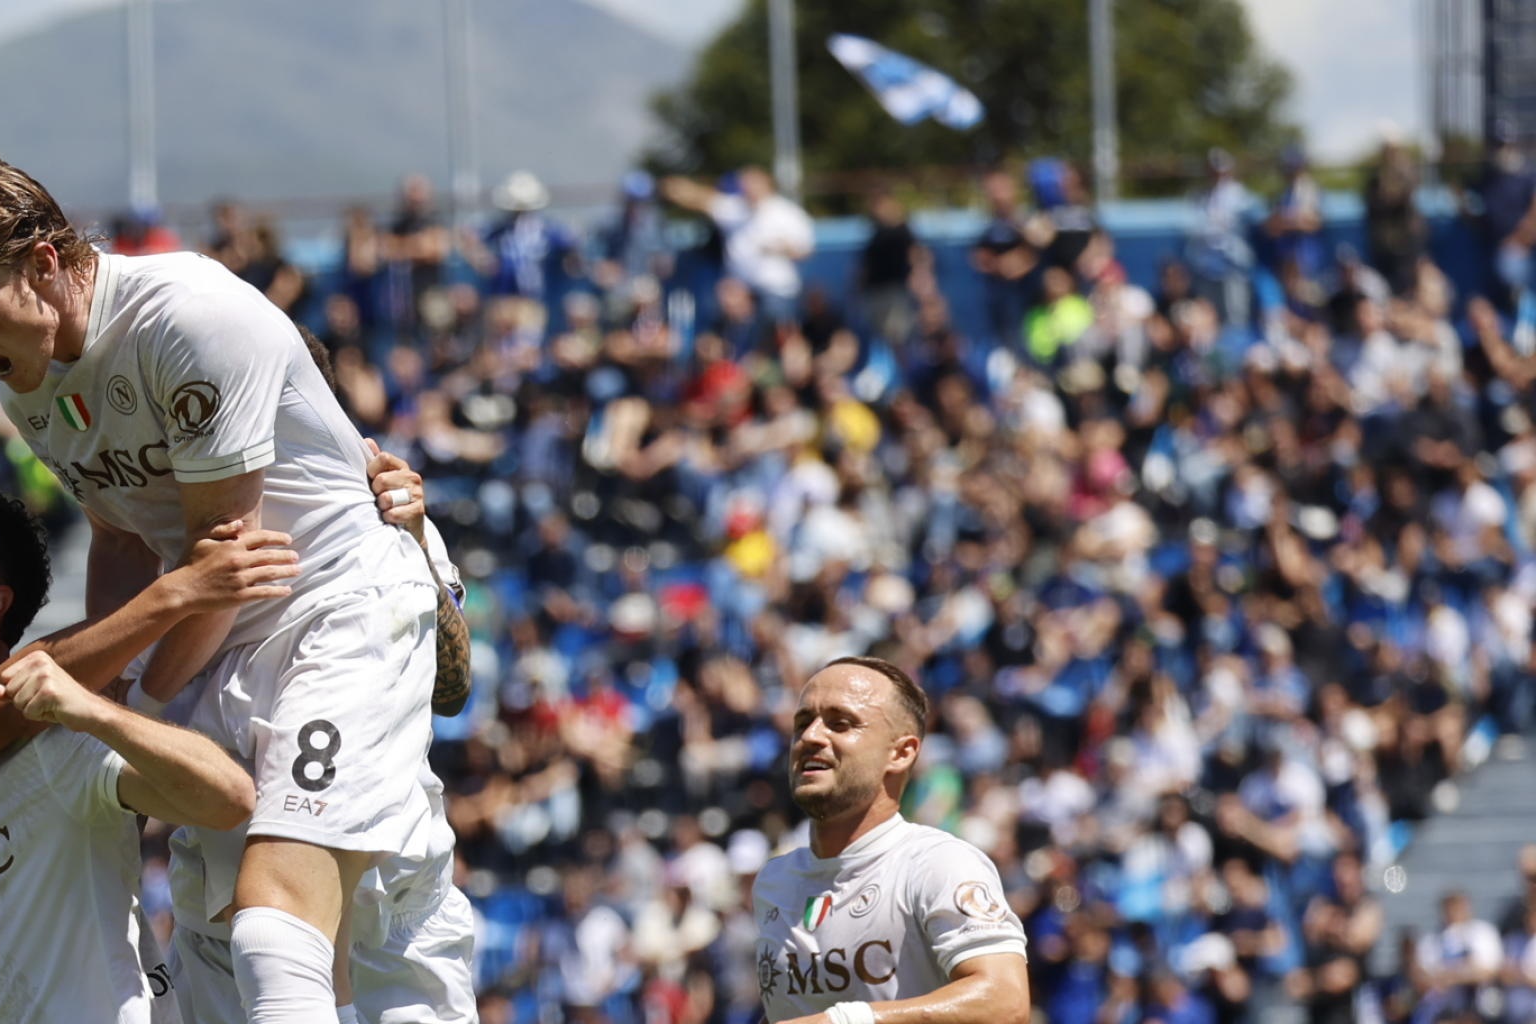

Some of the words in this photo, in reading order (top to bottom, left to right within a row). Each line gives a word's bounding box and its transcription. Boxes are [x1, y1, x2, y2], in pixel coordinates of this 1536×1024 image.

[71, 439, 173, 489] MSC
[291, 718, 342, 792] 8
[283, 794, 329, 817] EA7
[785, 939, 896, 995] MSC
